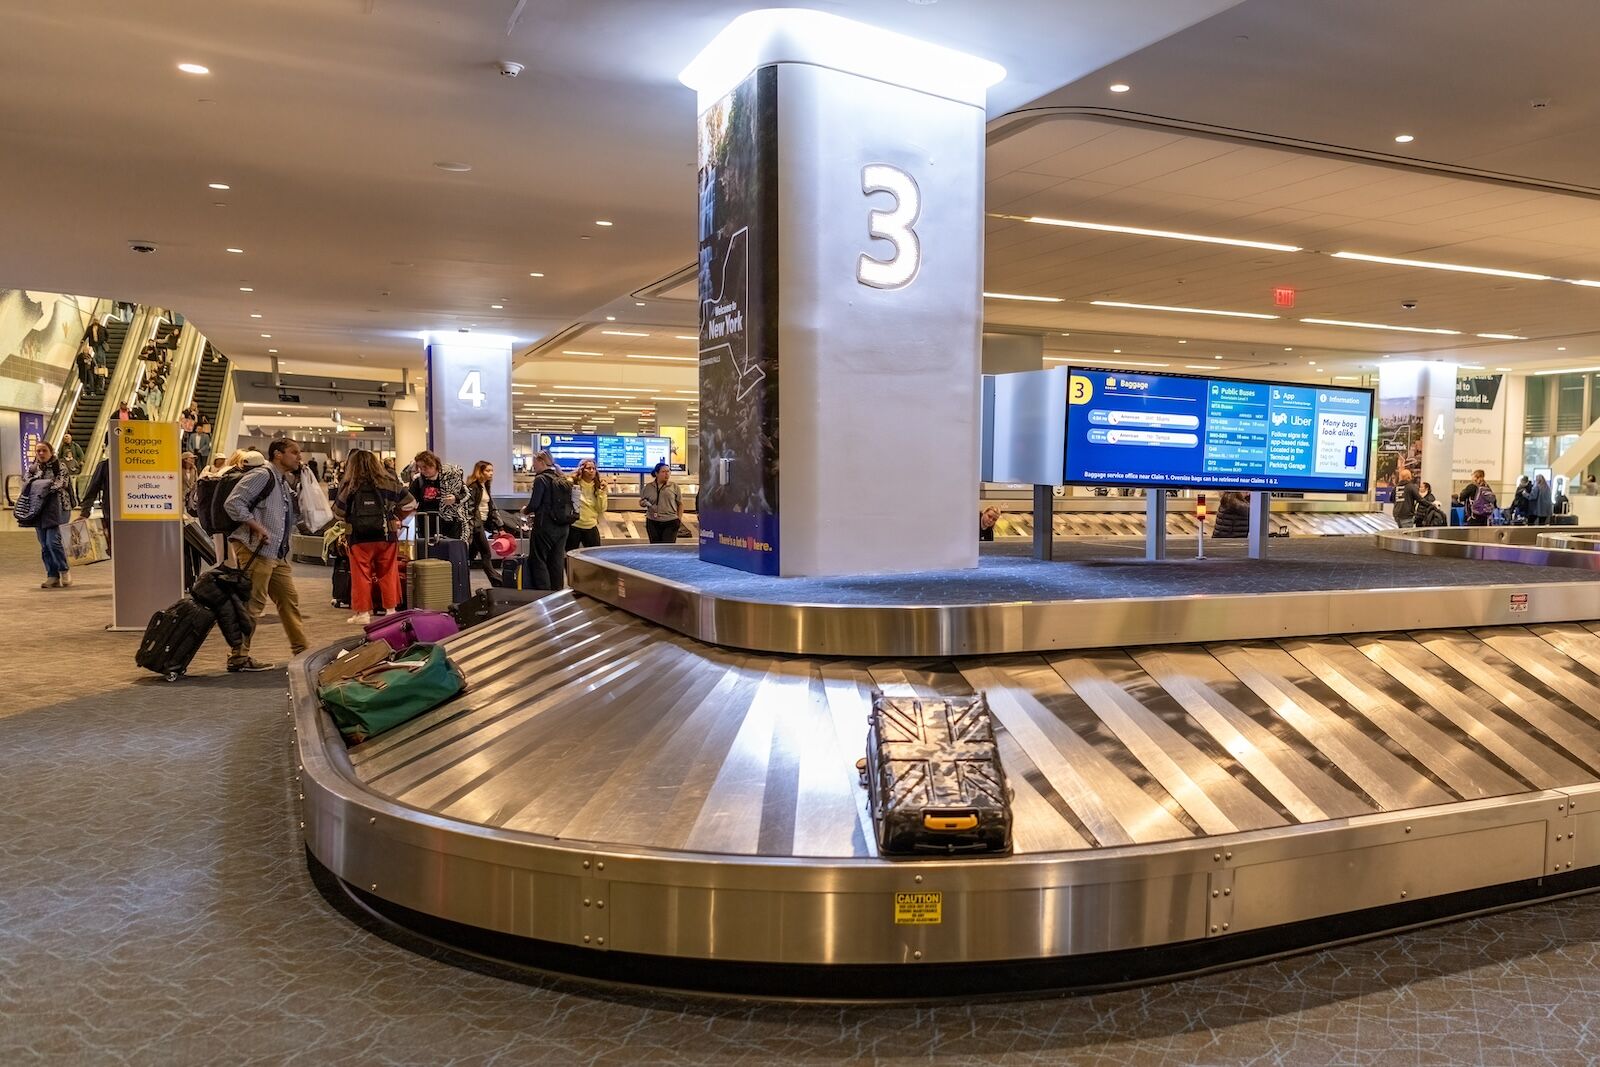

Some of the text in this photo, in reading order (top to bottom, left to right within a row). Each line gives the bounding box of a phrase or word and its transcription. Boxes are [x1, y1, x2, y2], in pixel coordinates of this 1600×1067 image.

[856, 162, 921, 289] 3
[708, 310, 743, 340] New York
[456, 369, 487, 409] 4
[1120, 379, 1149, 390] Baggage
[1462, 381, 1471, 391] to
[1074, 382, 1085, 399] 3
[1221, 387, 1256, 397] Public Buses
[1282, 392, 1296, 400] App
[1329, 395, 1360, 404] Information
[1271, 411, 1313, 427] lyft Uber
[1322, 418, 1358, 430] Many bags
[1432, 413, 1445, 440] 4
[1271, 430, 1287, 438] Follow
[1287, 432, 1300, 440] signs
[1321, 427, 1356, 437] look alike.
[124, 436, 162, 447] Baggage
[124, 446, 160, 455] Services
[125, 457, 156, 465] Offices
[1270, 453, 1290, 461] Terminal
[1269, 461, 1306, 470] Parking Garage
[1084, 471, 1106, 479] Baggage
[1190, 475, 1202, 483] bags
[137, 482, 160, 490] jetBlue
[753, 538, 773, 552] here.
[897, 894, 939, 903] CAUTION
